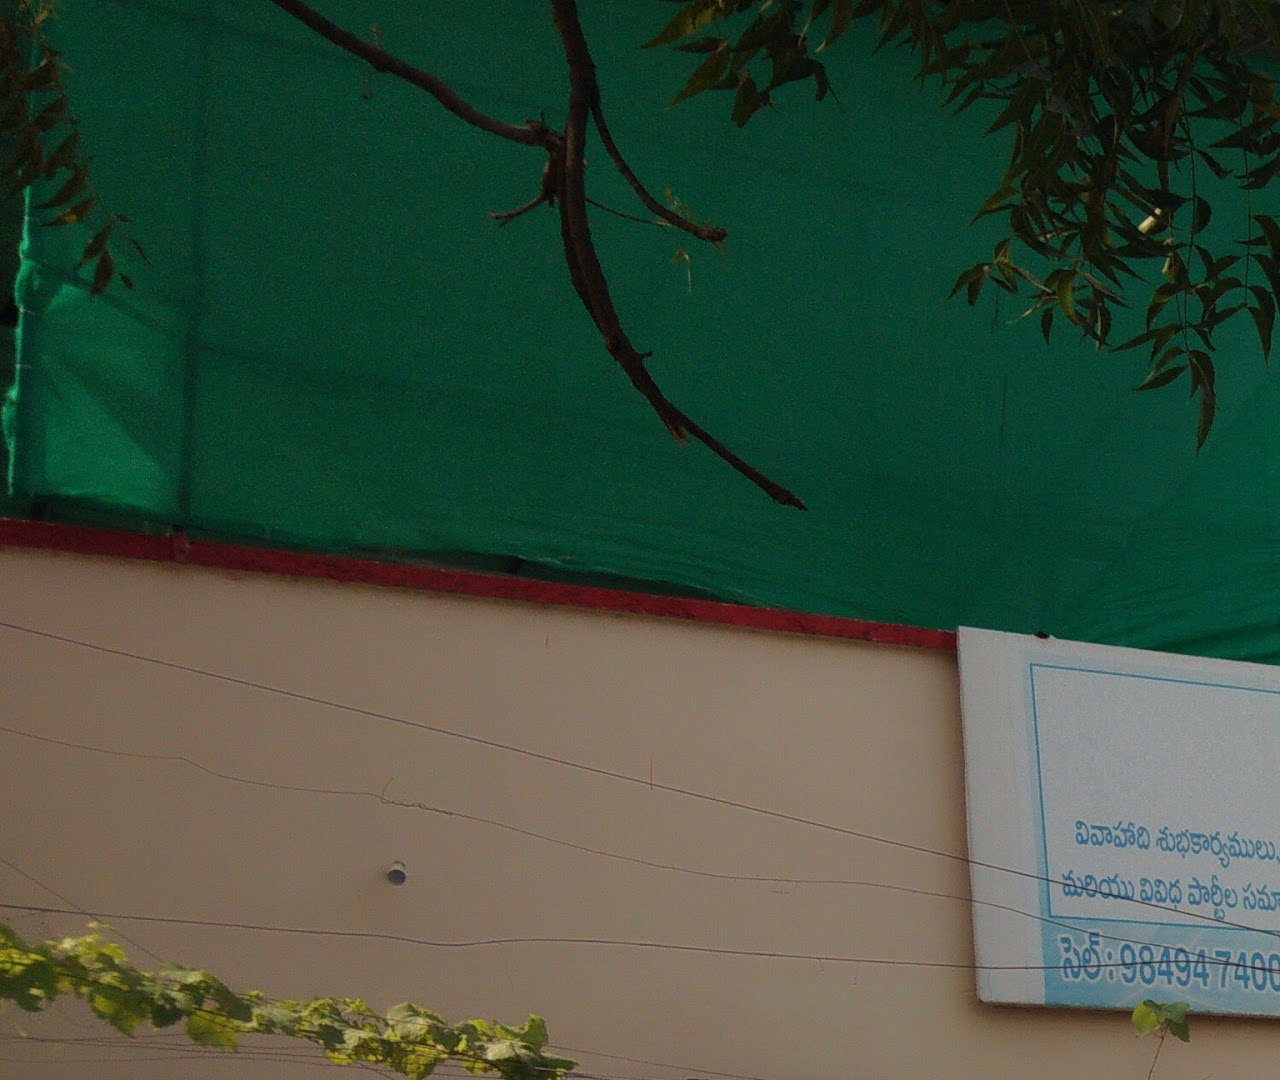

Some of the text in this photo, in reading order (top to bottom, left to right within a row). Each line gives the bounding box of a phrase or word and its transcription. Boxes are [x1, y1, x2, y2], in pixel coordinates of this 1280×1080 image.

[1074, 820, 1151, 850] వివాహాది
[1061, 869, 1135, 900] మరియు
[1139, 877, 1183, 909] వివిధ
[1187, 874, 1239, 921] పార్టీల
